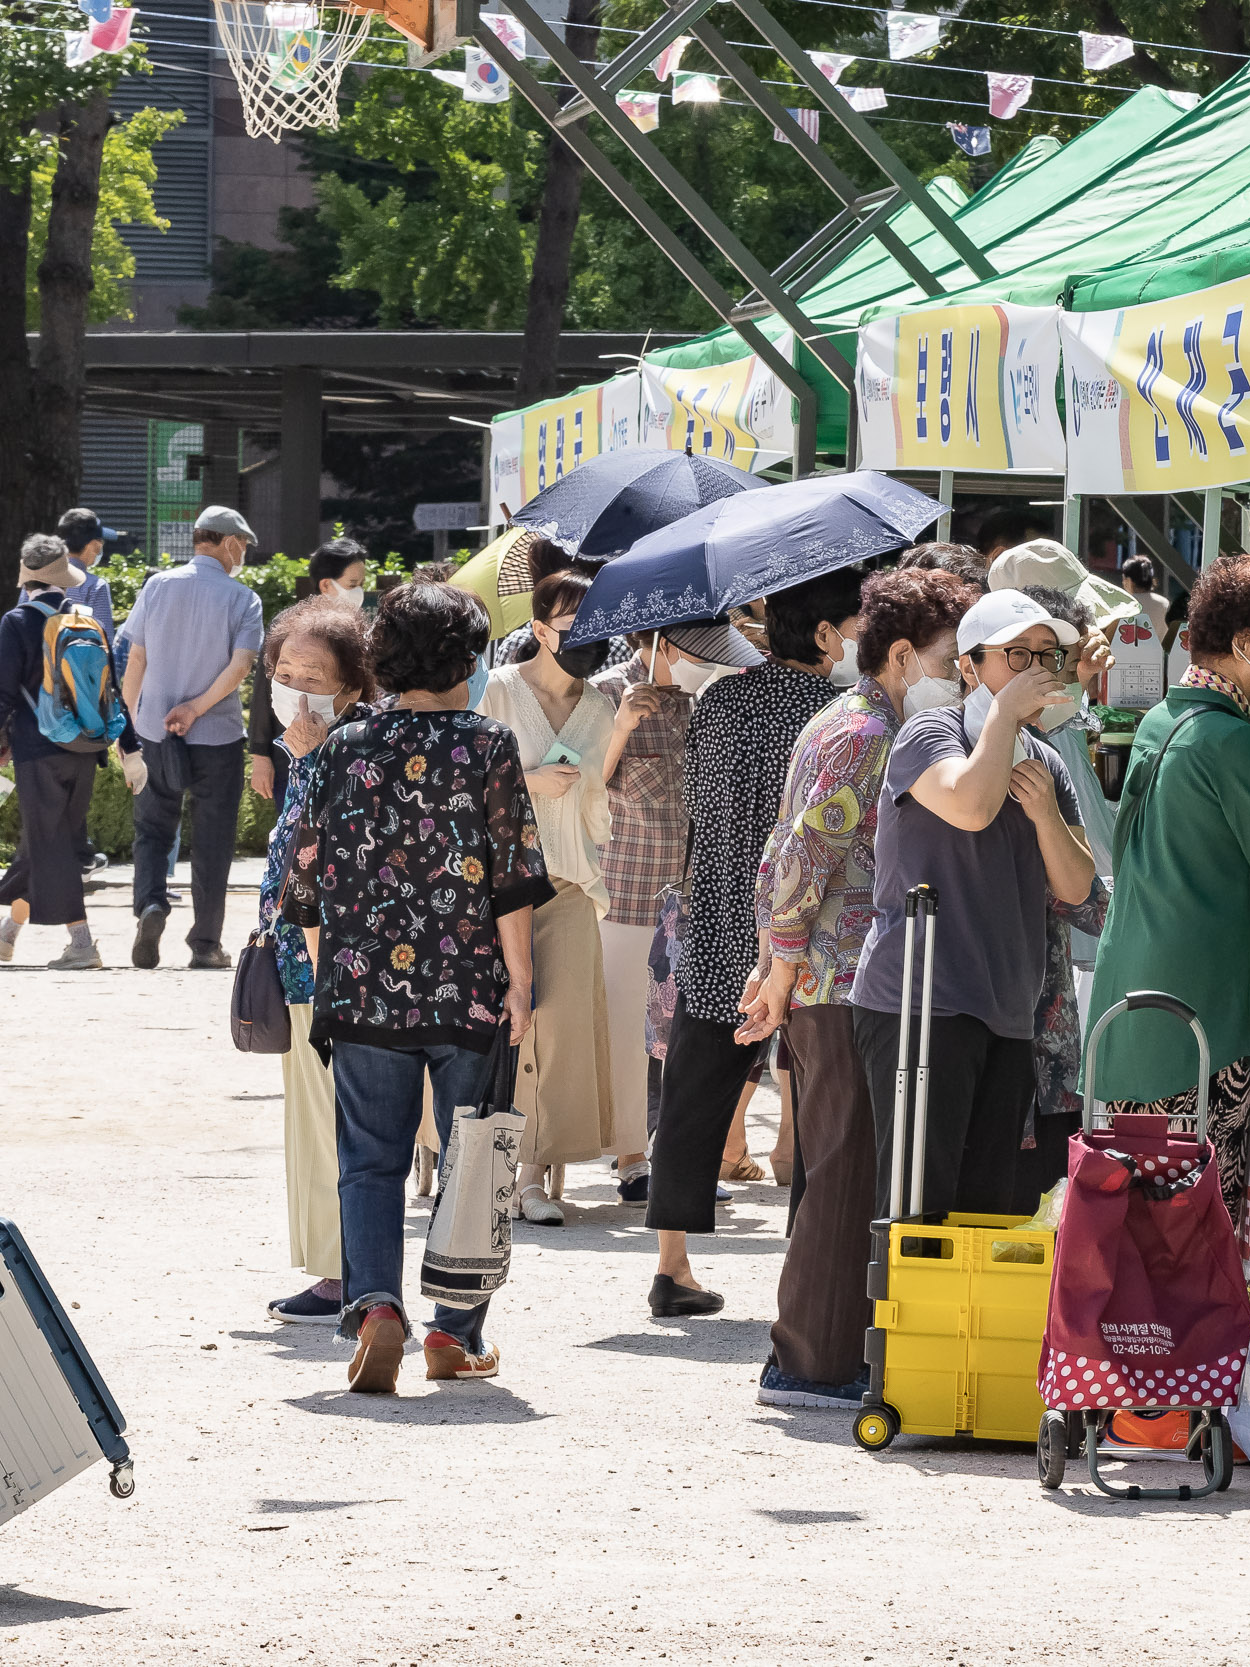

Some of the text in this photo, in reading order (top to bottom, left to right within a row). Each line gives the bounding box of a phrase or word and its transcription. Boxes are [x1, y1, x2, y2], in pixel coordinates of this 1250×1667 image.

[916, 329, 980, 443] 보령시
[1137, 310, 1250, 462] 인제군
[1120, 1323, 1149, 1336] 사계절
[1150, 1323, 1172, 1340] 한의원
